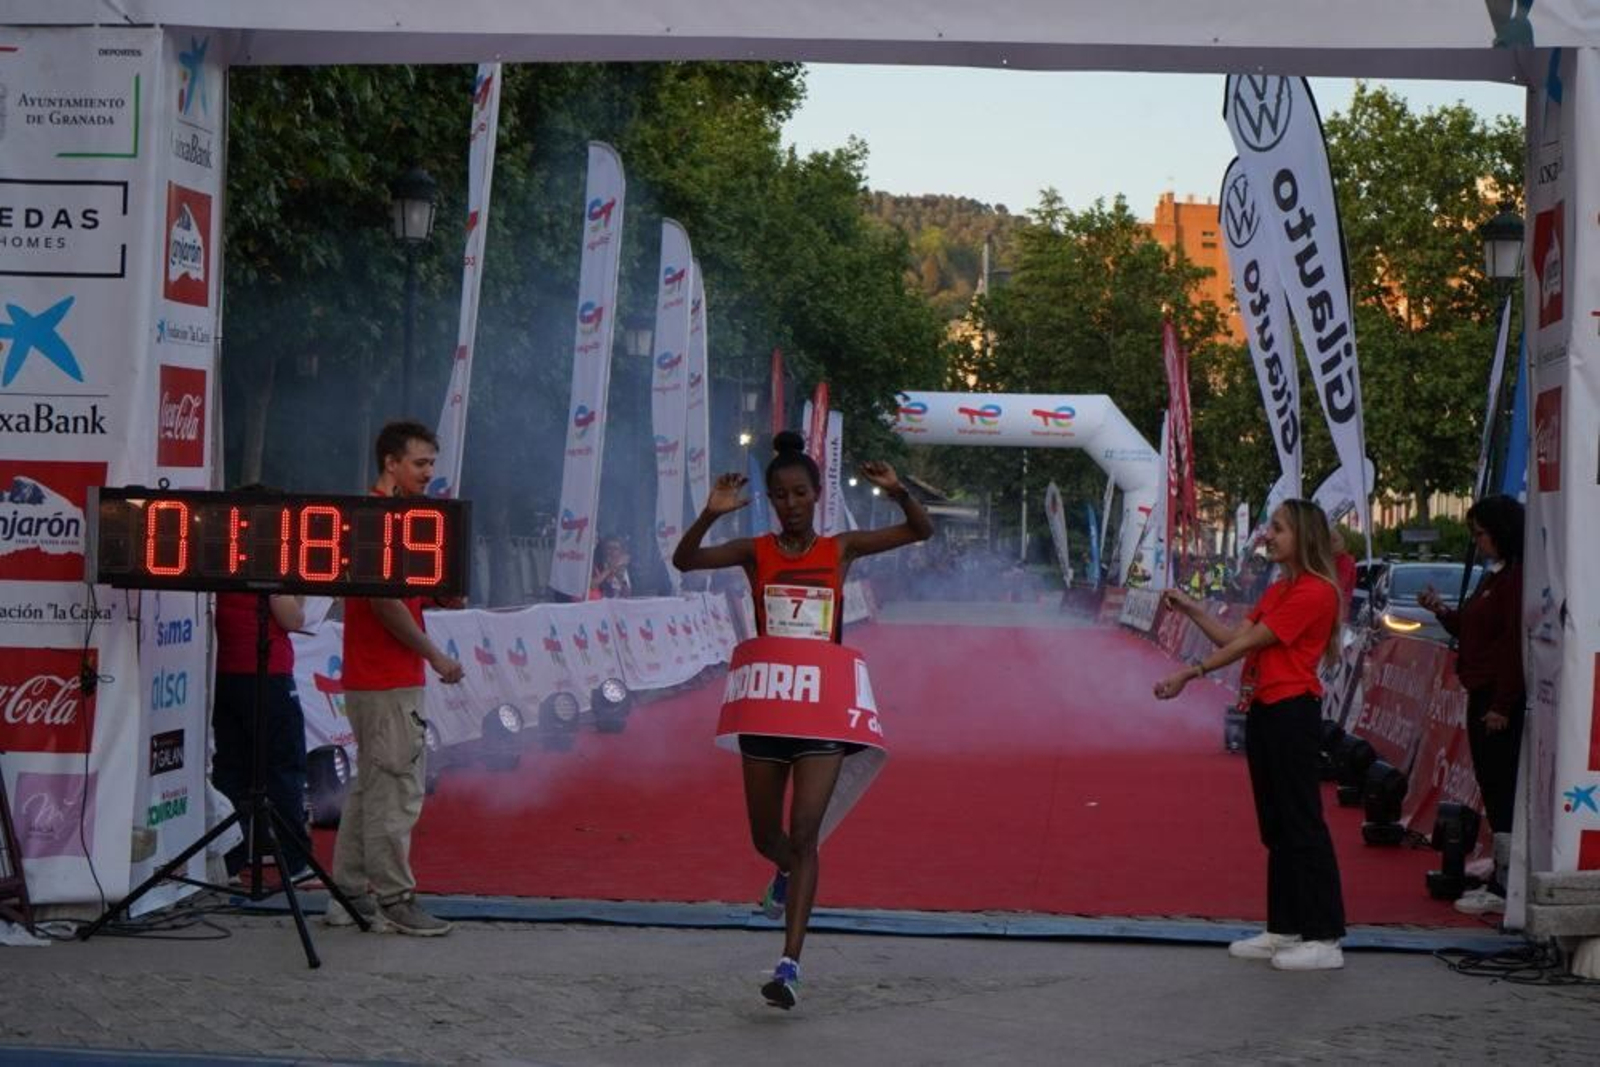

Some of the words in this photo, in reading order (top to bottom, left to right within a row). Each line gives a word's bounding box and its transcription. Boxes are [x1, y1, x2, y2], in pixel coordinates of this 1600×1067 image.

[0, 403, 107, 434] xaBank
[791, 599, 804, 619] 7
[848, 709, 861, 728] 7
